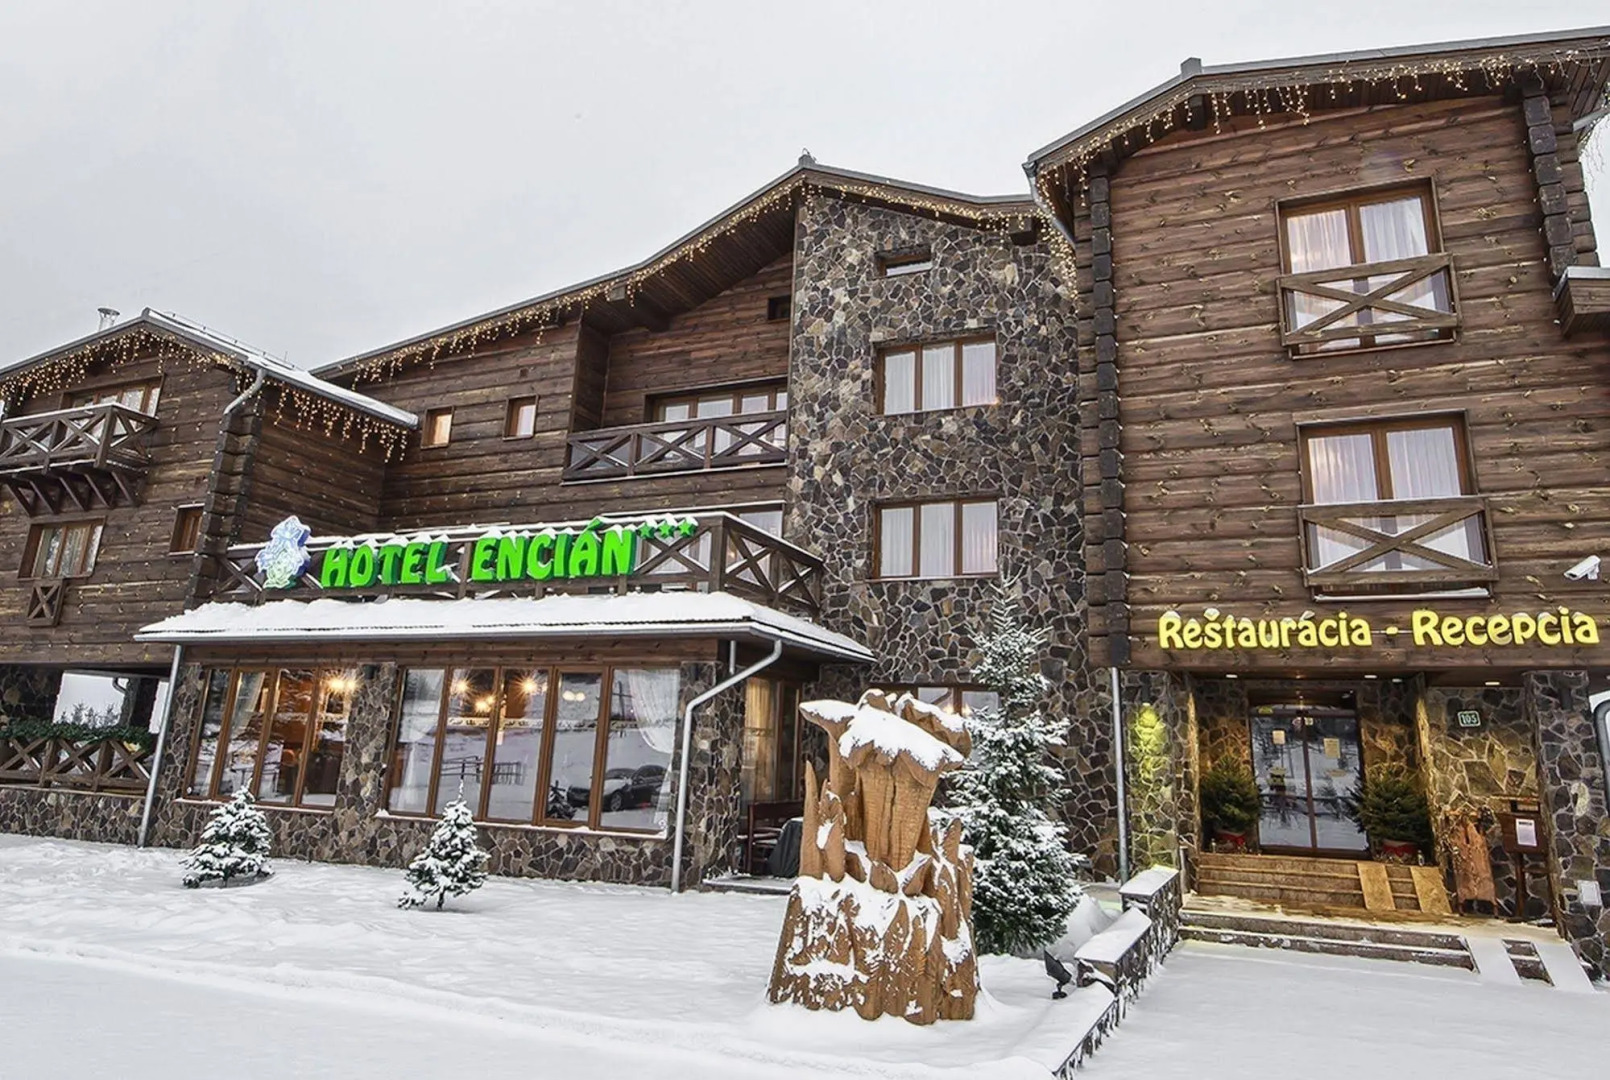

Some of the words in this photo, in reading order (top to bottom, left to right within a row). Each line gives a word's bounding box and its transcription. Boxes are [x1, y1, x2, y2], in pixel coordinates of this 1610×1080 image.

[321, 541, 449, 588] HOTEL
[471, 517, 637, 582] ENCIÁN
[1158, 607, 1373, 649] Reštaurácia
[1411, 606, 1600, 646] Recepcia
